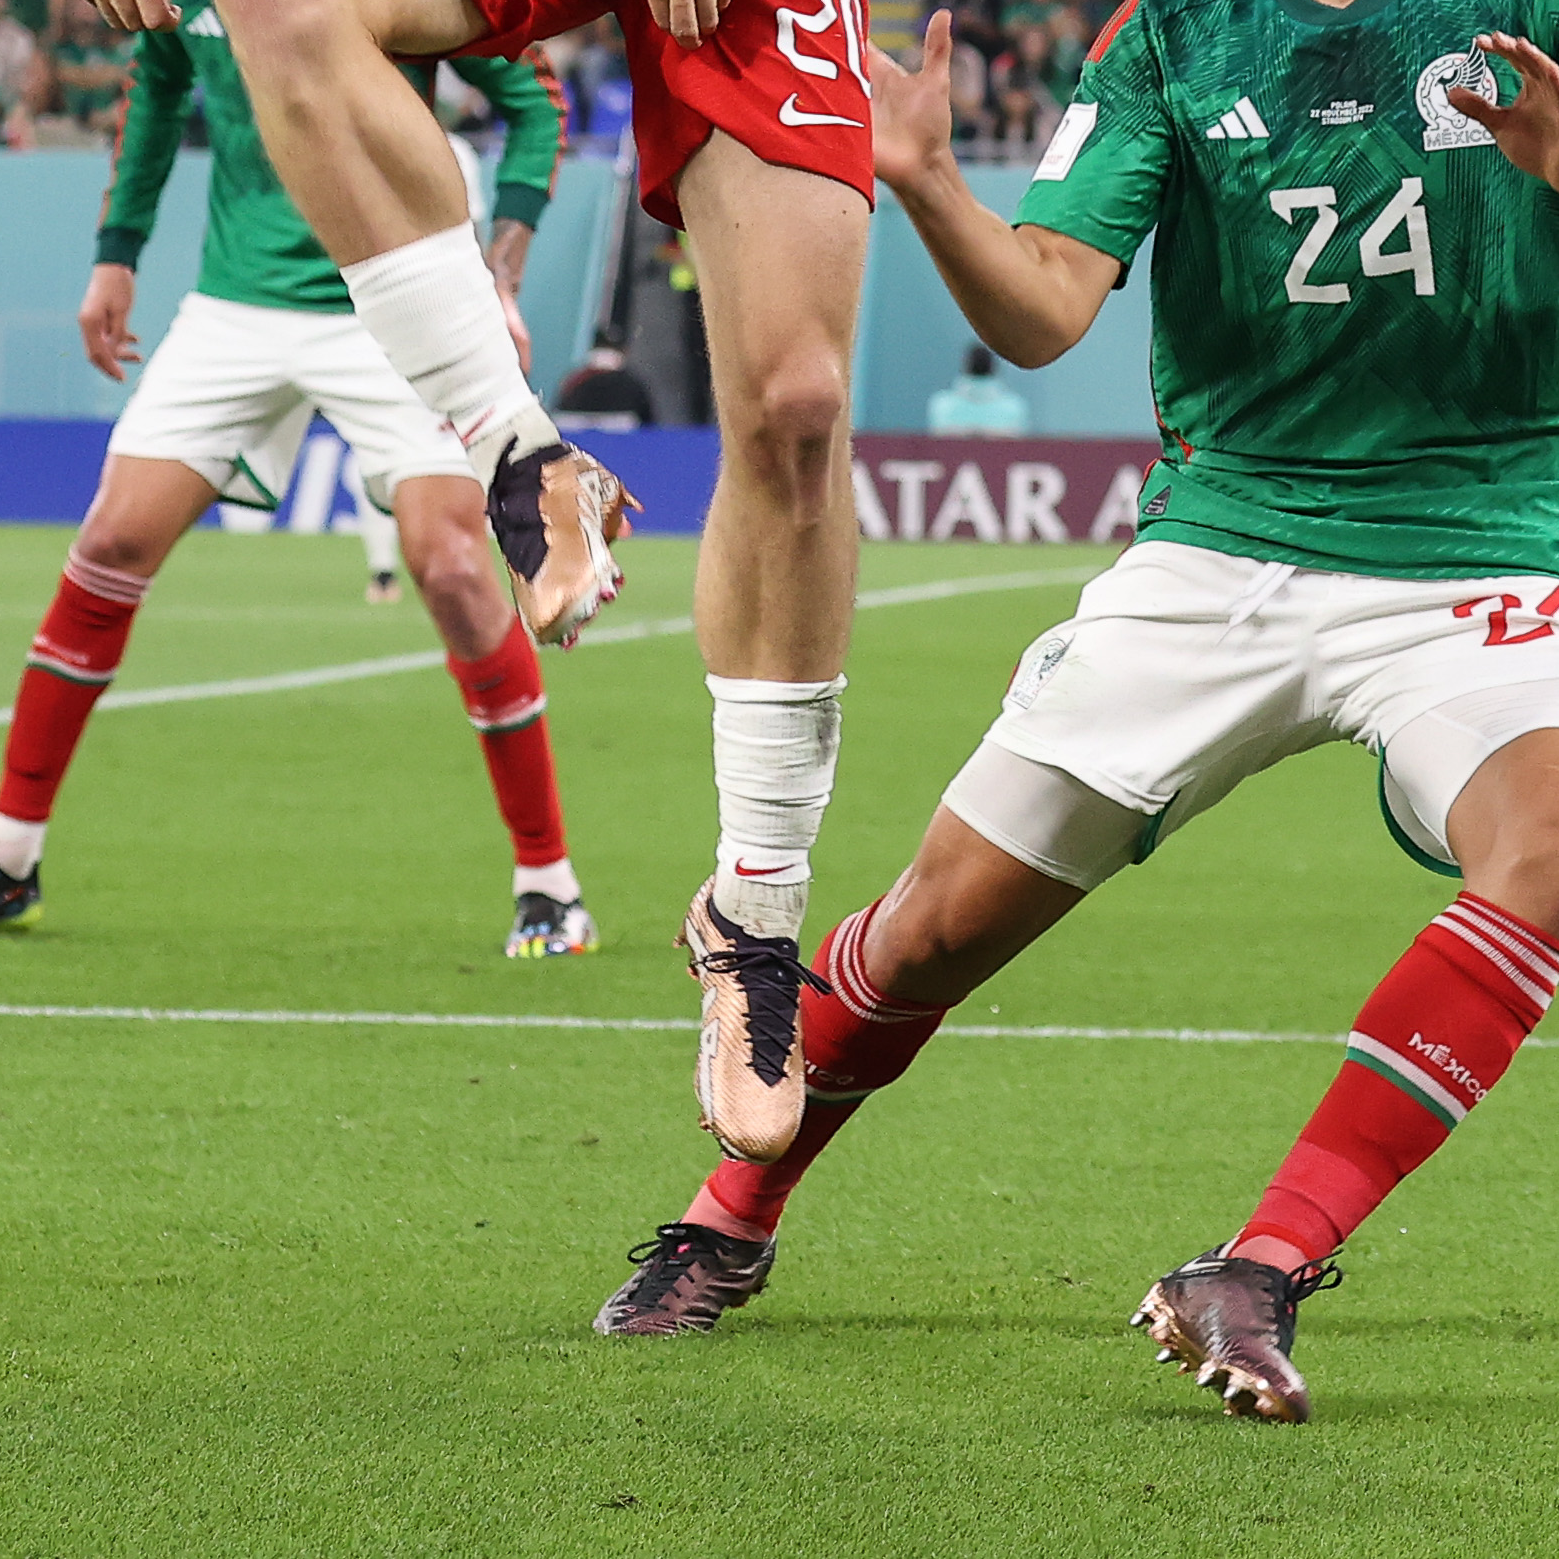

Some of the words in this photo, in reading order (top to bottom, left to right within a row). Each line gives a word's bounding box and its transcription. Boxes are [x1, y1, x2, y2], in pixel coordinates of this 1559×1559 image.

[1309, 108, 1321, 118] 22
[1269, 176, 1436, 304] 24
[1406, 1031, 1490, 1103] MÉXICO
